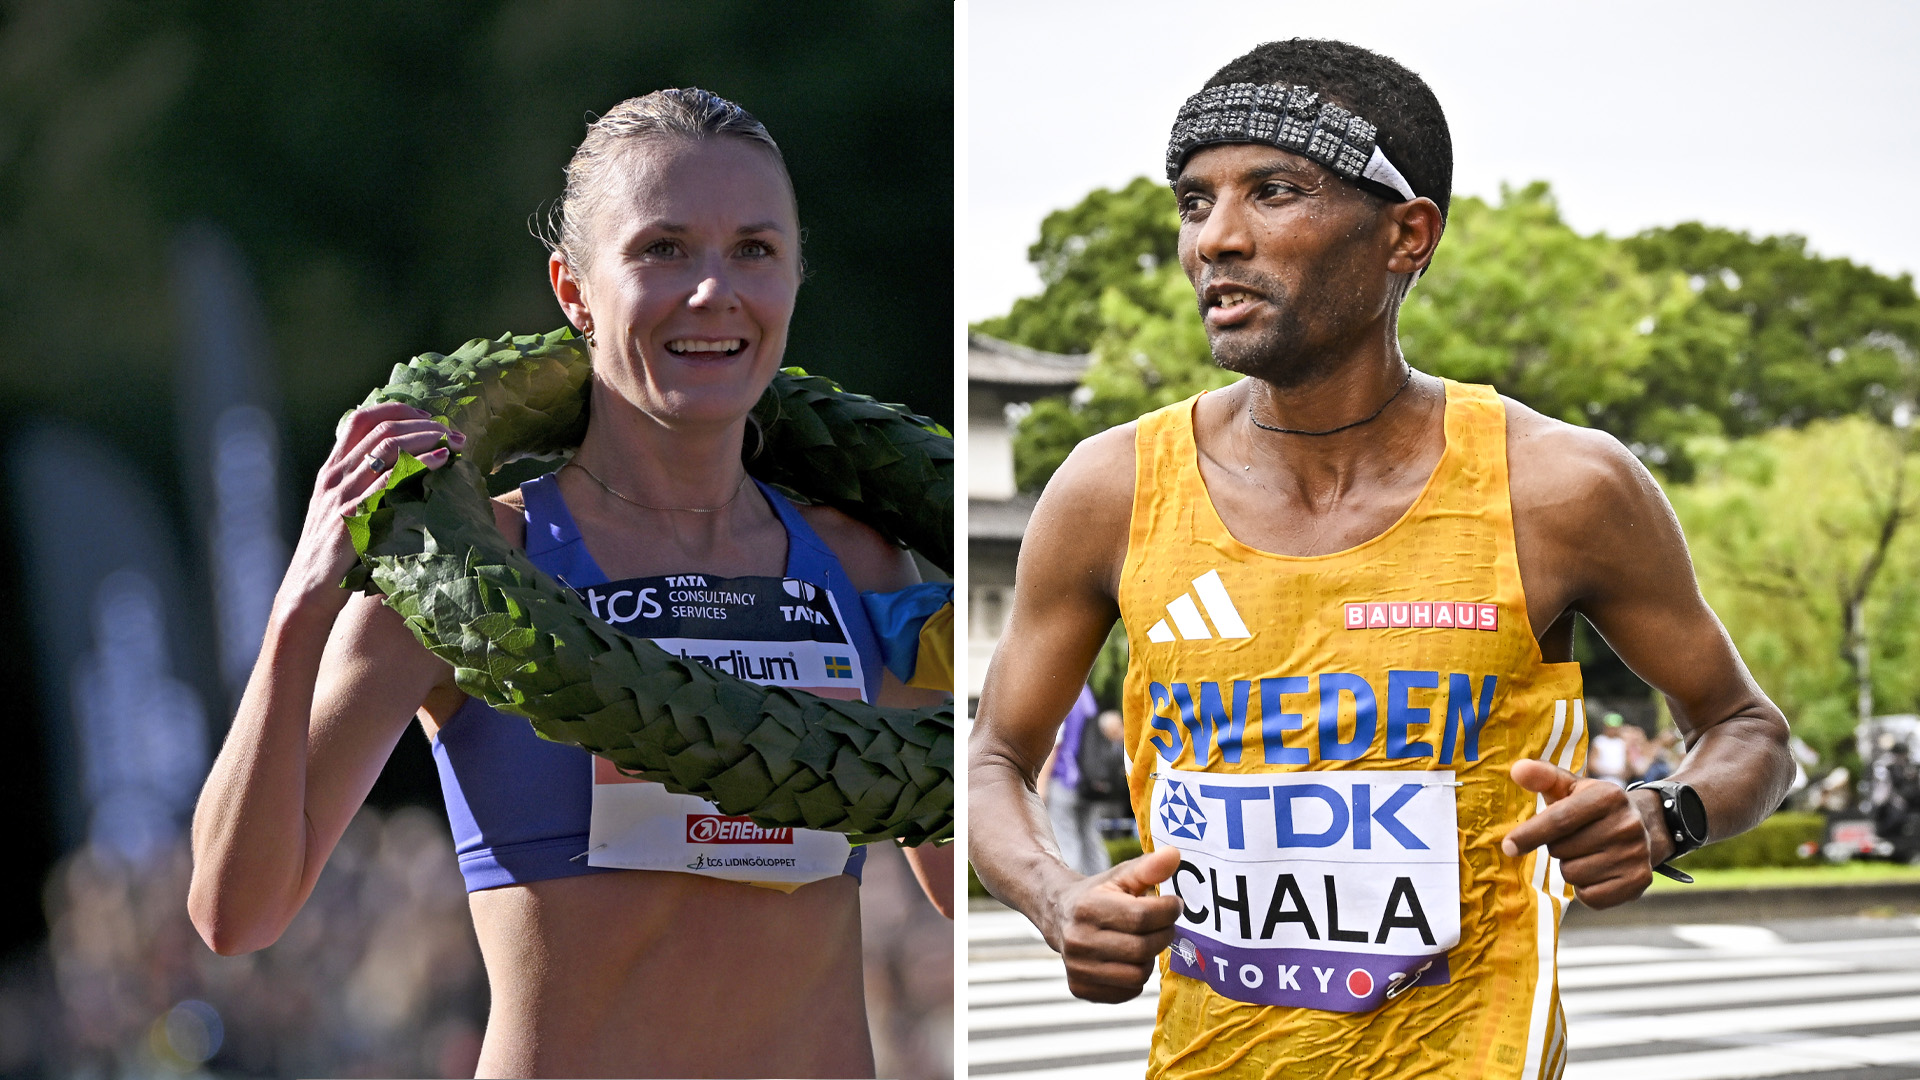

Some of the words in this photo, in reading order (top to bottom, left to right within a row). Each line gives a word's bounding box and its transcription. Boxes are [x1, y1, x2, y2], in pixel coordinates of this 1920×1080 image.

[665, 575, 708, 588] TATA
[588, 587, 662, 624] tcs
[669, 590, 756, 606] CONSULTANCY
[672, 606, 727, 620] SERVICES
[780, 605, 830, 627] TATA
[1347, 605, 1497, 627] BAUHAUS
[1148, 670, 1498, 766] SWEDEN
[1200, 783, 1431, 850] TDK
[707, 857, 723, 867] tcs
[725, 856, 796, 867] LIDINGÖLOPPET
[1175, 862, 1438, 946] CHALA
